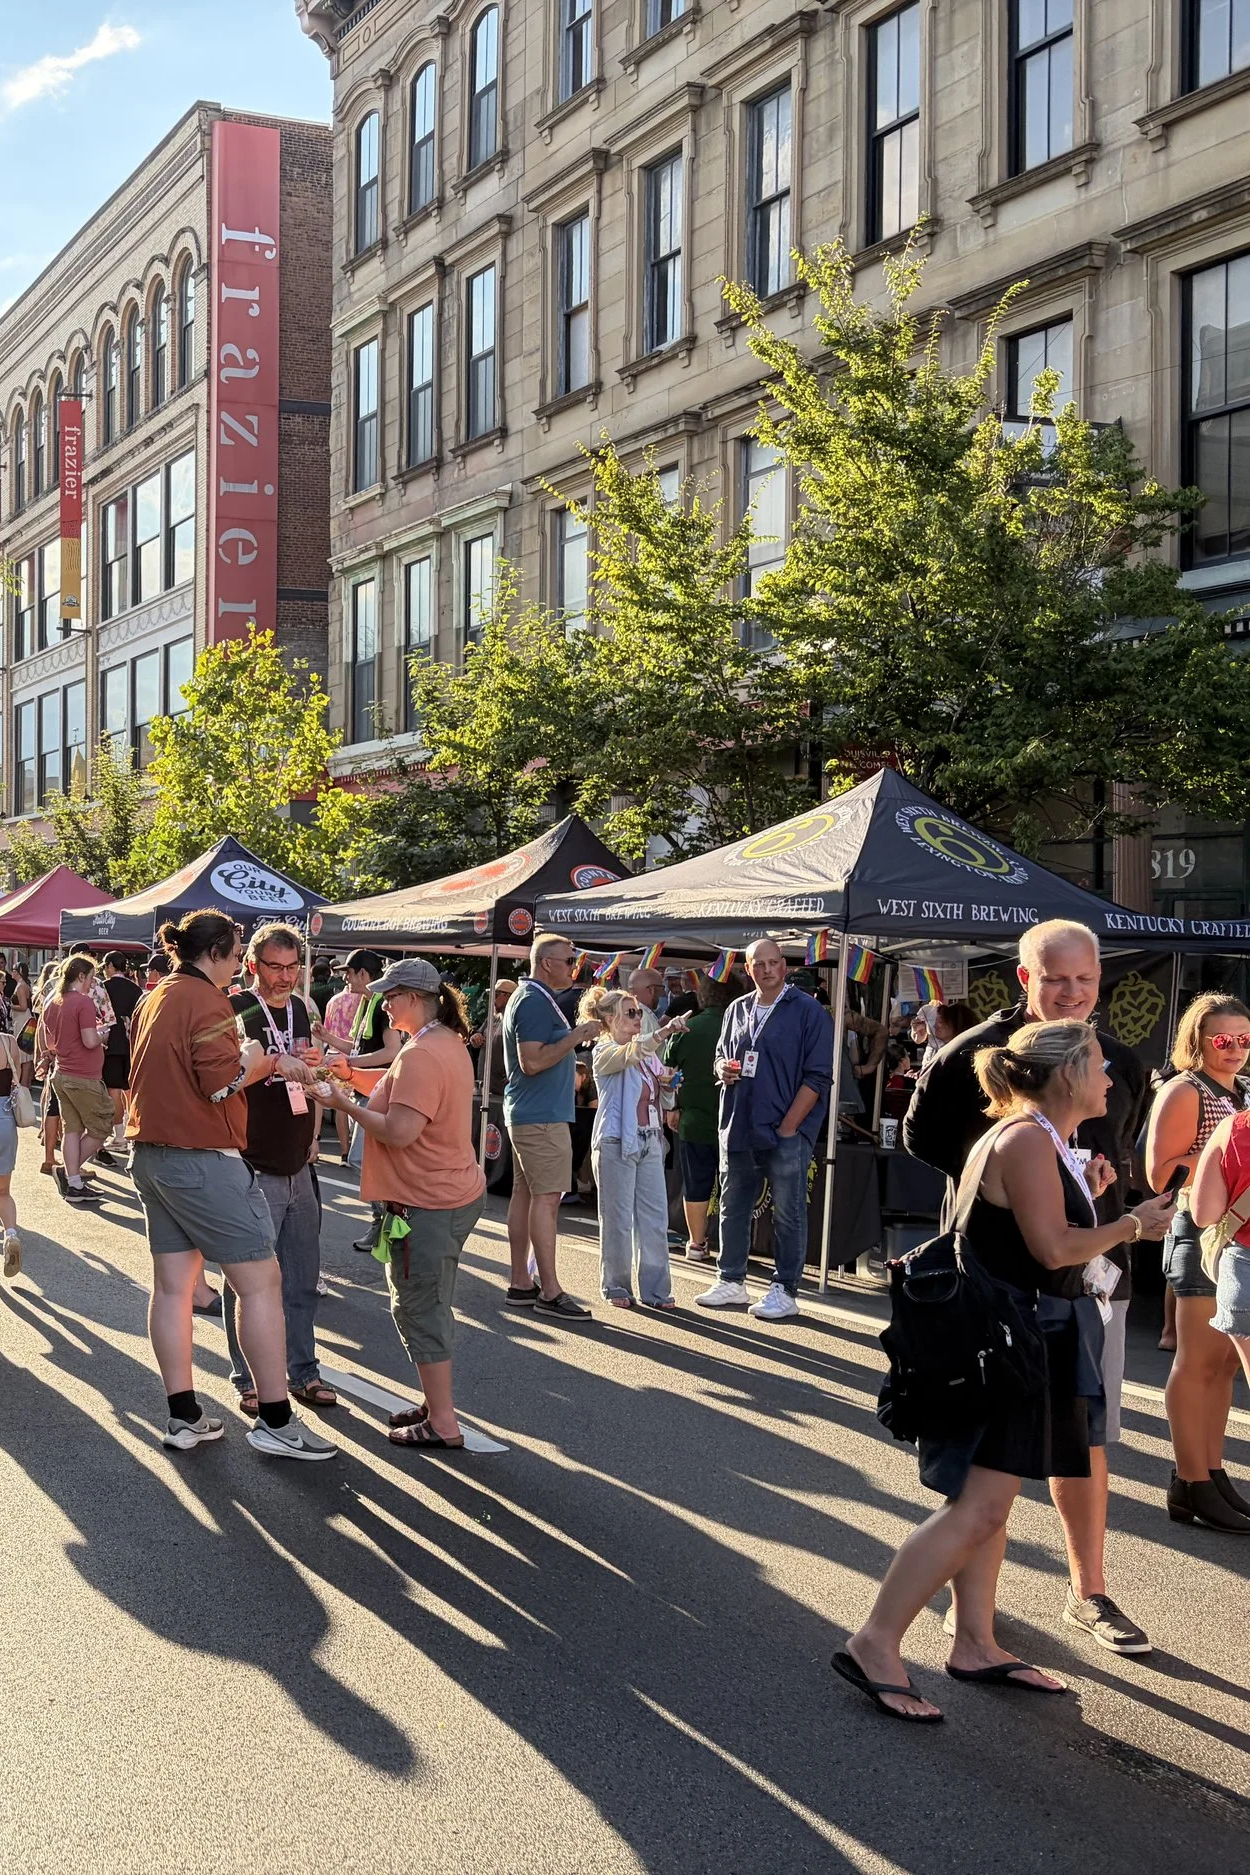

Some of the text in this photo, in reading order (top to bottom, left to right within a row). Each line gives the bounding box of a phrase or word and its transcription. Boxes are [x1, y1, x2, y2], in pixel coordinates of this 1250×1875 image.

[218, 222, 278, 628] frazier
[64, 426, 82, 500] frazier
[233, 864, 262, 875] OUR
[217, 869, 291, 898] City
[248, 894, 289, 904] BEER
[548, 909, 573, 923] WEST
[574, 908, 601, 923] SIXTH
[605, 906, 652, 922] BREWING
[877, 898, 1039, 924] WEST SIXTH BREWING
[1104, 913, 1185, 934] KENTUCKY
